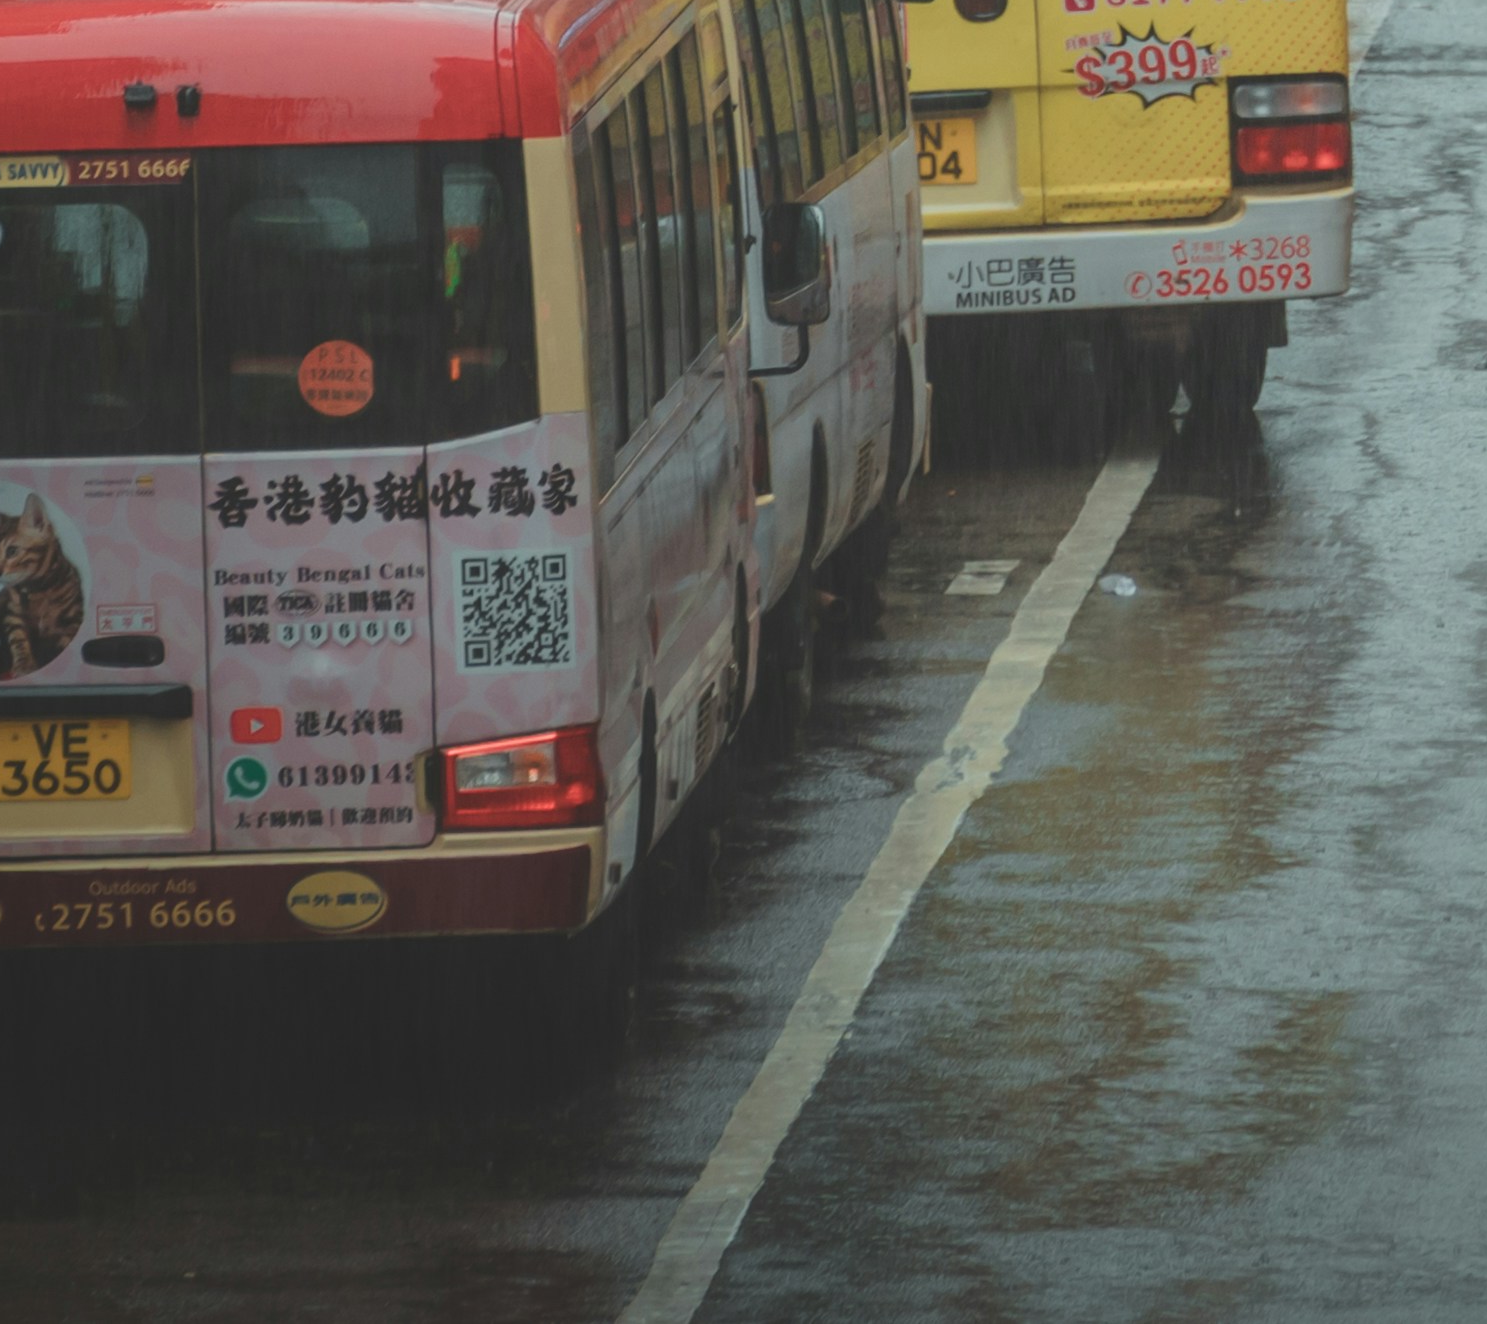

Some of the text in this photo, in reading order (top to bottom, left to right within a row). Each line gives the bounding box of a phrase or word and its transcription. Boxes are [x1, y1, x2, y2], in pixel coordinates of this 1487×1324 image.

[1075, 38, 1197, 98] $399
[7, 162, 61, 181] SAVVY
[78, 160, 130, 180] 2751
[954, 255, 1076, 289] 小巴廣告
[1155, 262, 1312, 299] 3526 0593
[955, 286, 1076, 310] MINIBUS AD
[209, 462, 579, 529] 香港豹貓收藏家
[214, 561, 426, 588] Beauty Bengal Cats
[222, 593, 269, 618] 國際
[295, 708, 404, 738] 港女養貓
[31, 724, 91, 760] VE
[0, 760, 123, 799] 3650
[88, 877, 197, 897] Outdoor Ads
[51, 899, 237, 931] 2751 6666
